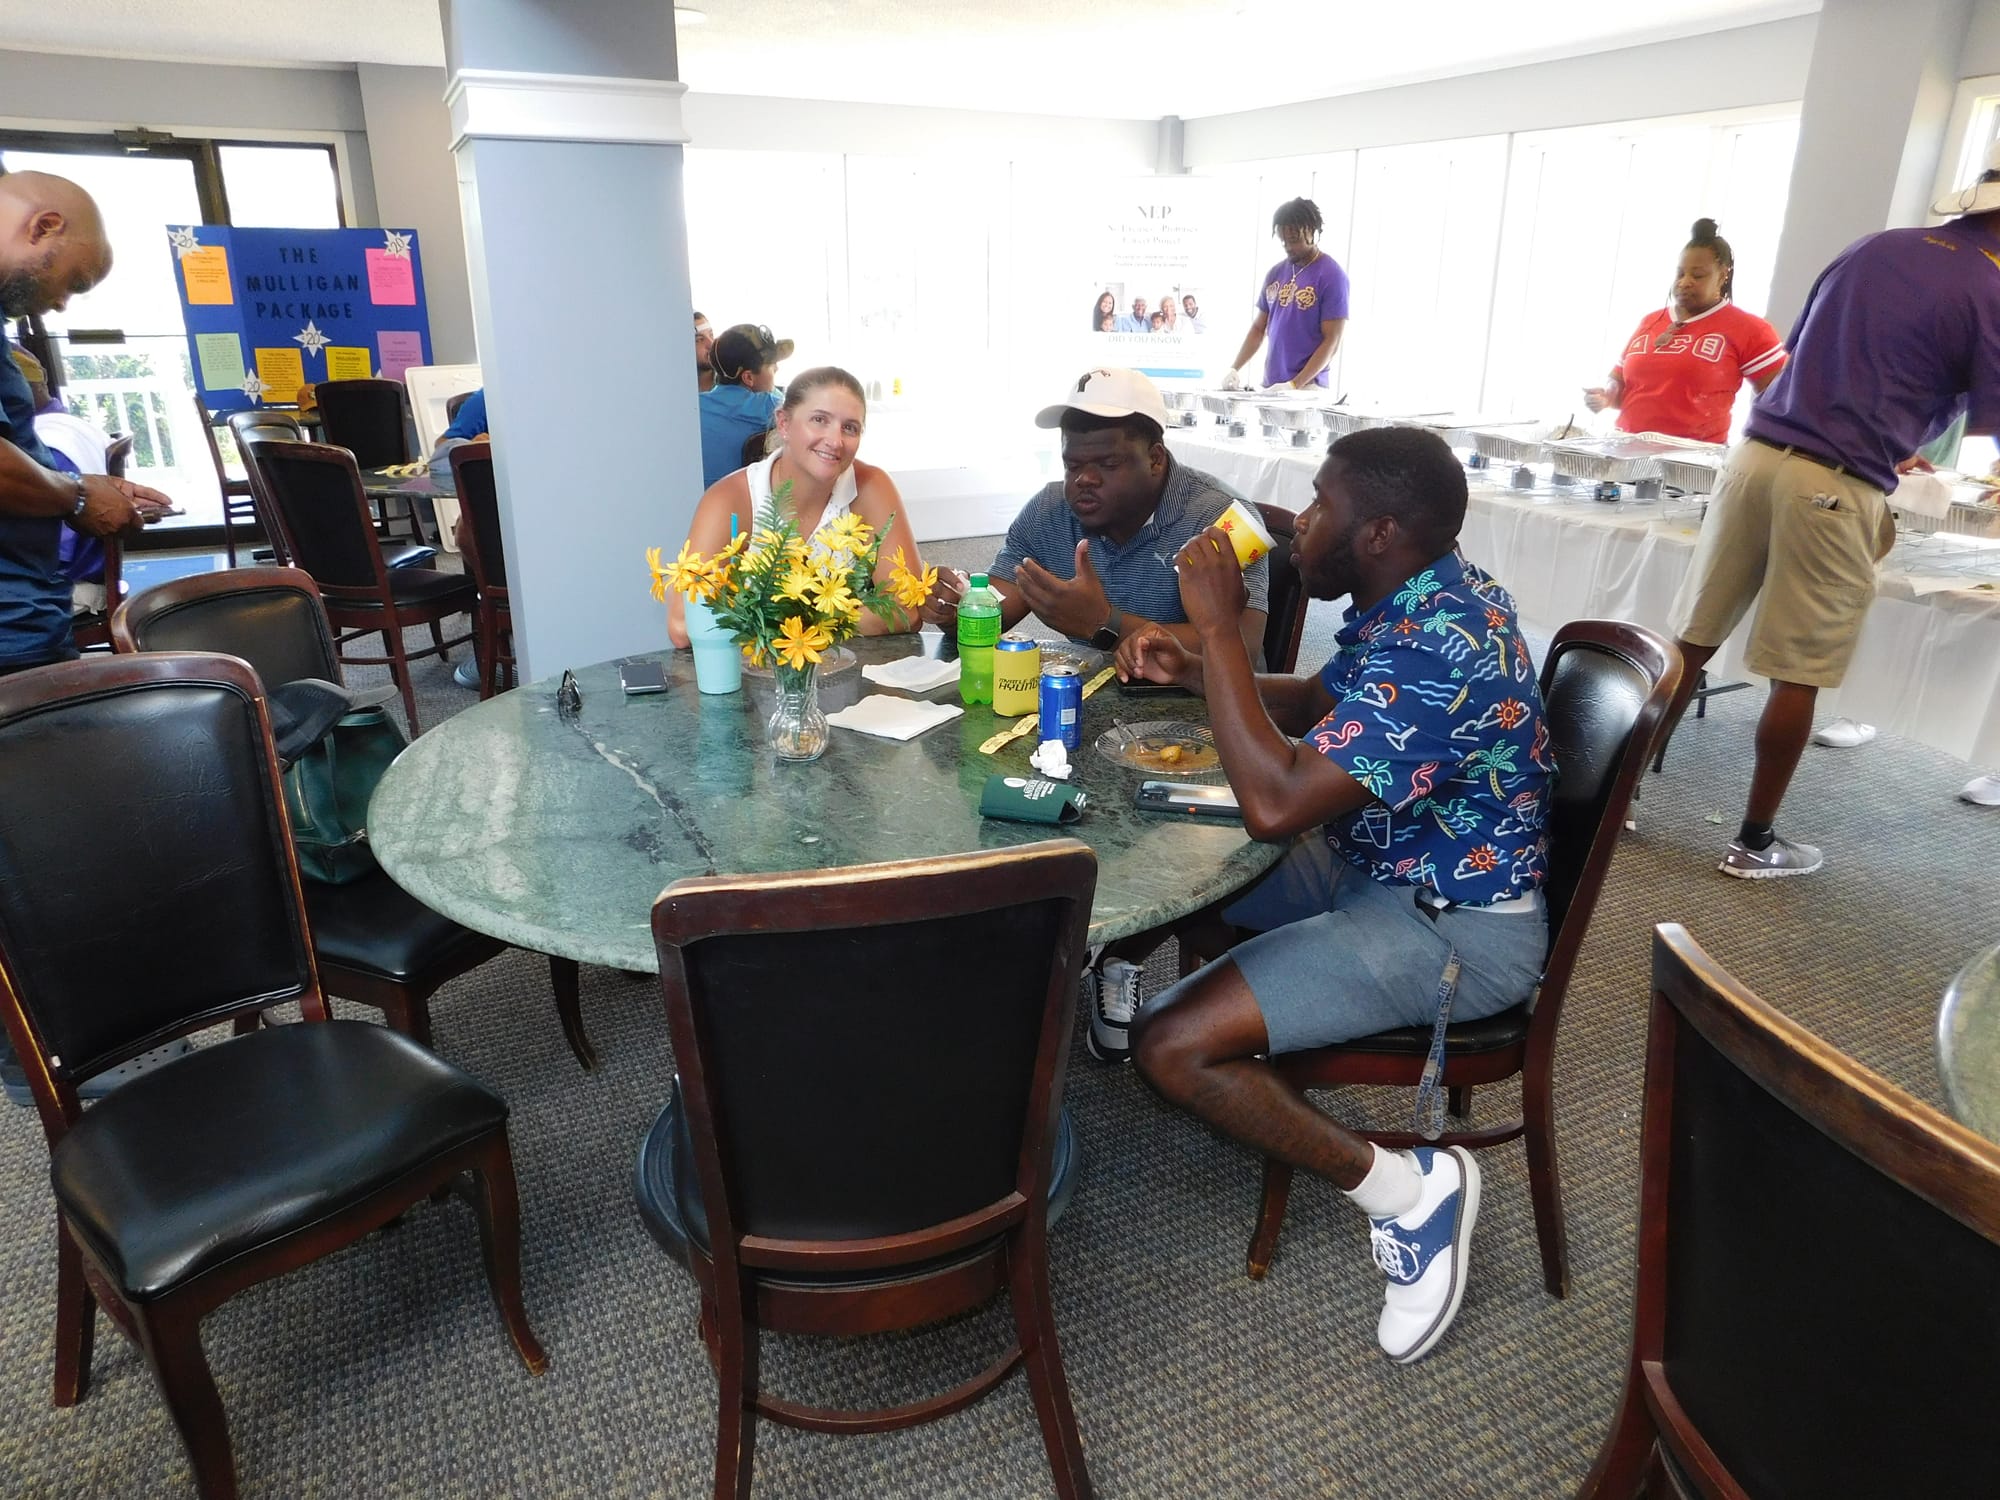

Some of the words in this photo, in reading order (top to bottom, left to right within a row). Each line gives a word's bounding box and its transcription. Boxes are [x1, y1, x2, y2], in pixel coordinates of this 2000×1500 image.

[280, 247, 318, 263] THE
[246, 274, 358, 291] MULLIGAN
[256, 302, 352, 319] PACKAGE
[1108, 335, 1125, 343] DID
[1128, 335, 1149, 343] YOU
[1150, 335, 1182, 344] KNOW
